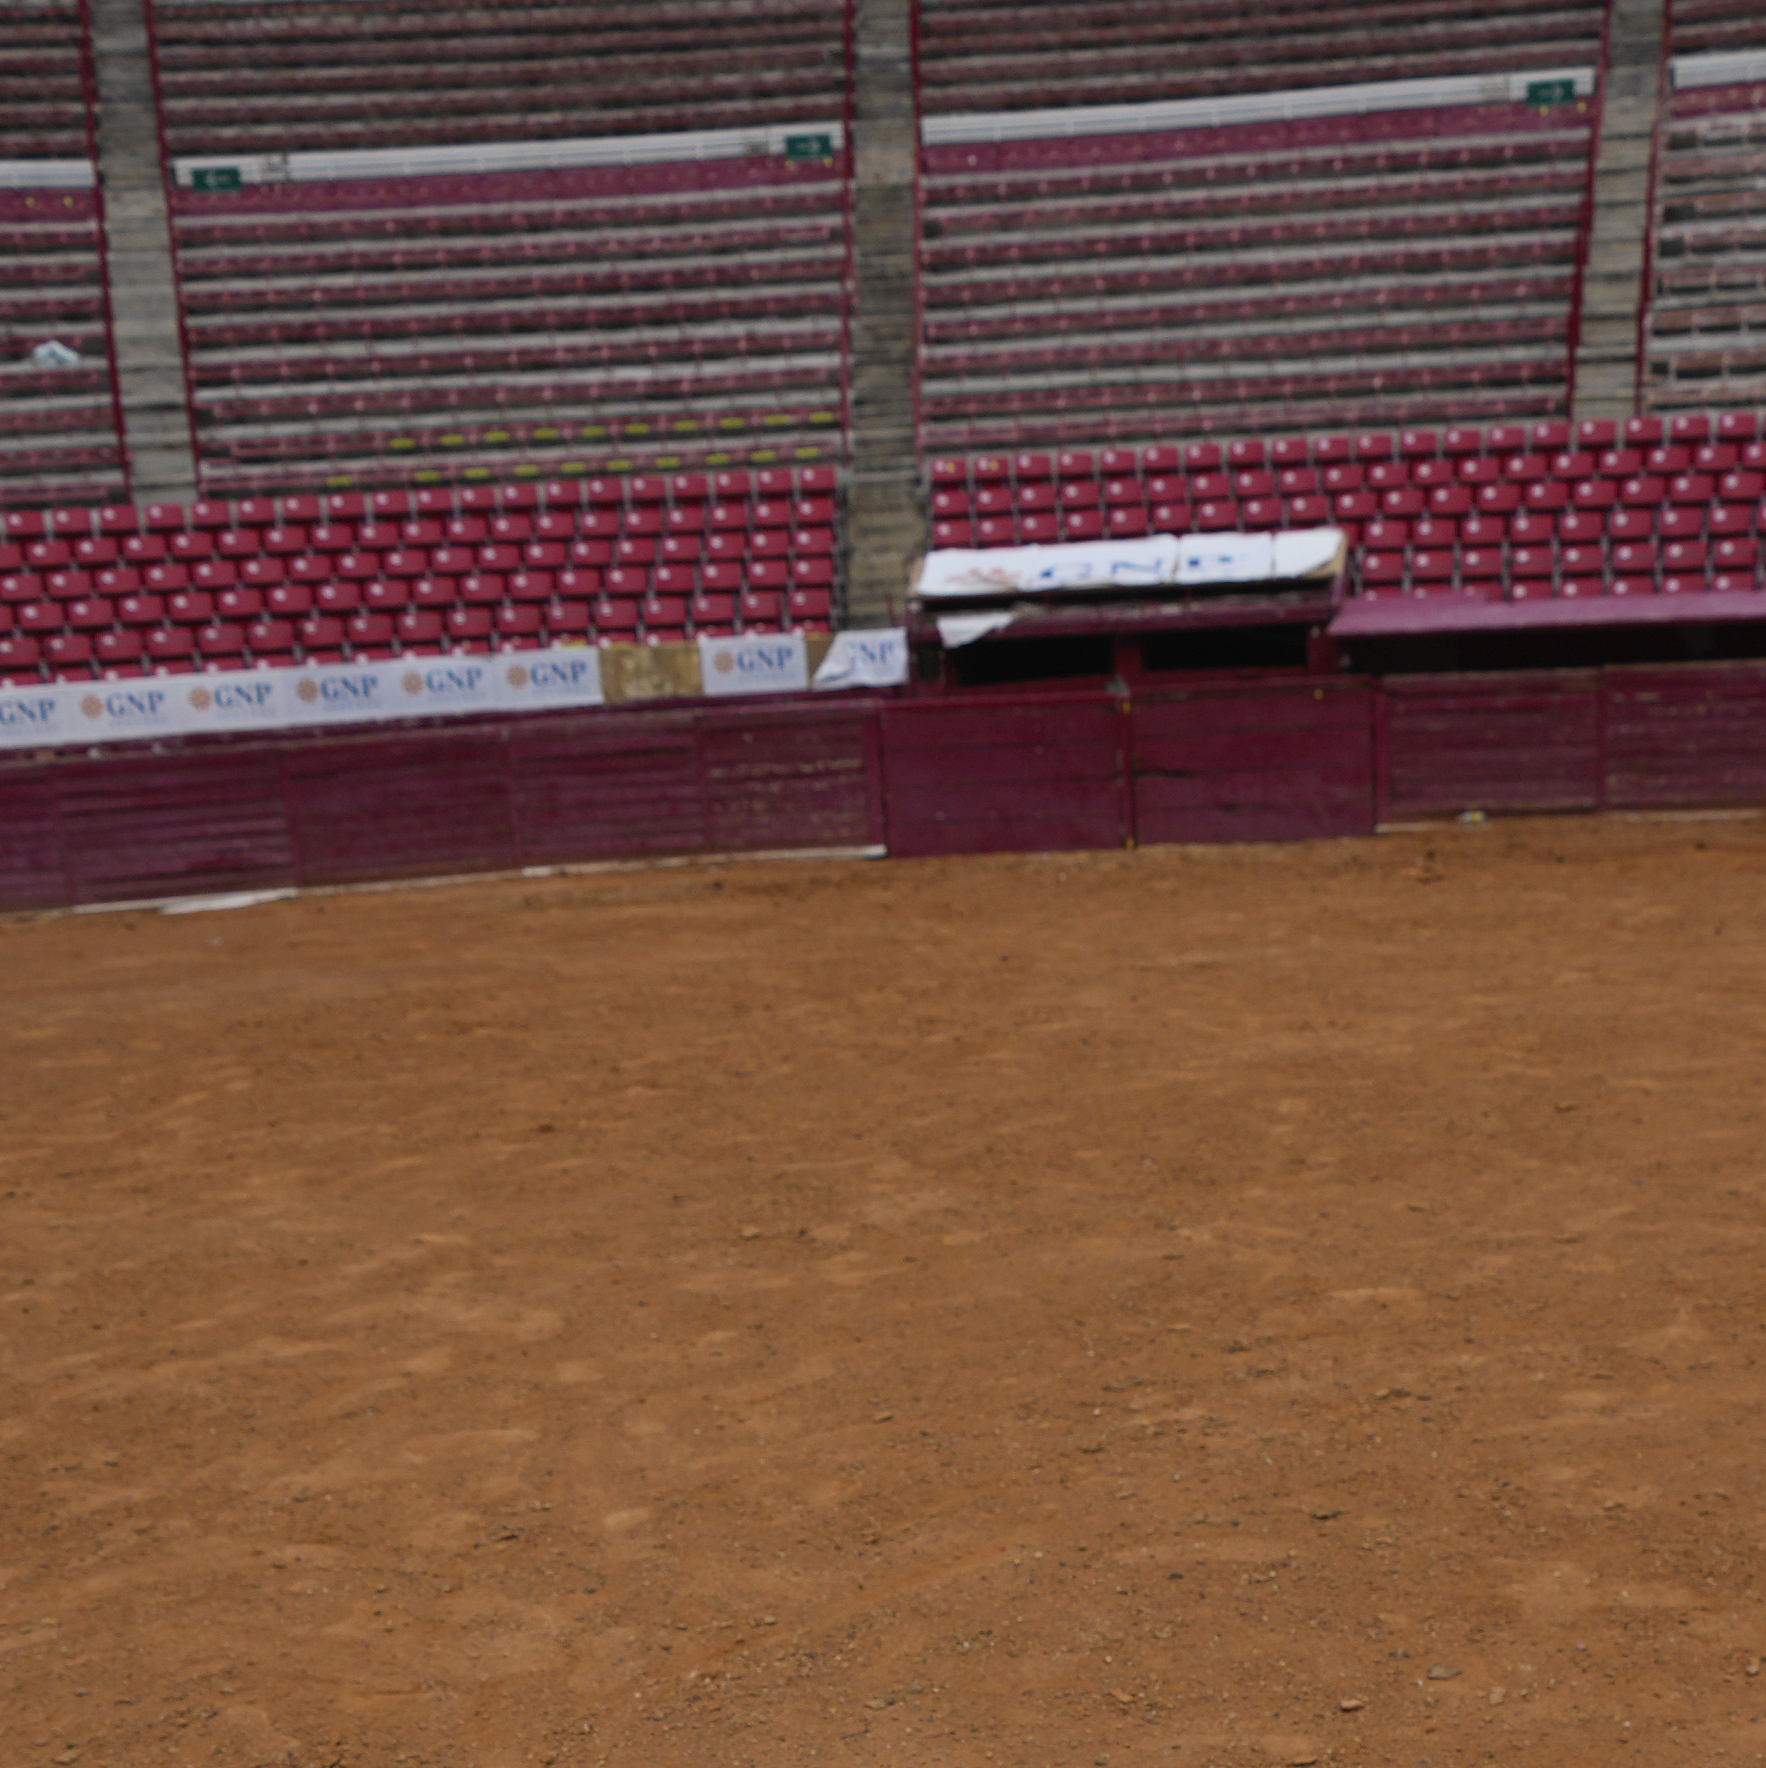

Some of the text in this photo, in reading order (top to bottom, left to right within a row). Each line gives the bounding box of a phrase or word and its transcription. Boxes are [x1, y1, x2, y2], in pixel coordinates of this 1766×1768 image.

[737, 646, 793, 672] GNP
[847, 640, 896, 666] NP
[426, 667, 483, 693] GNP
[531, 660, 587, 688] GNP
[215, 683, 272, 708] GNP
[321, 674, 379, 702] GNP
[106, 691, 164, 718] GNP
